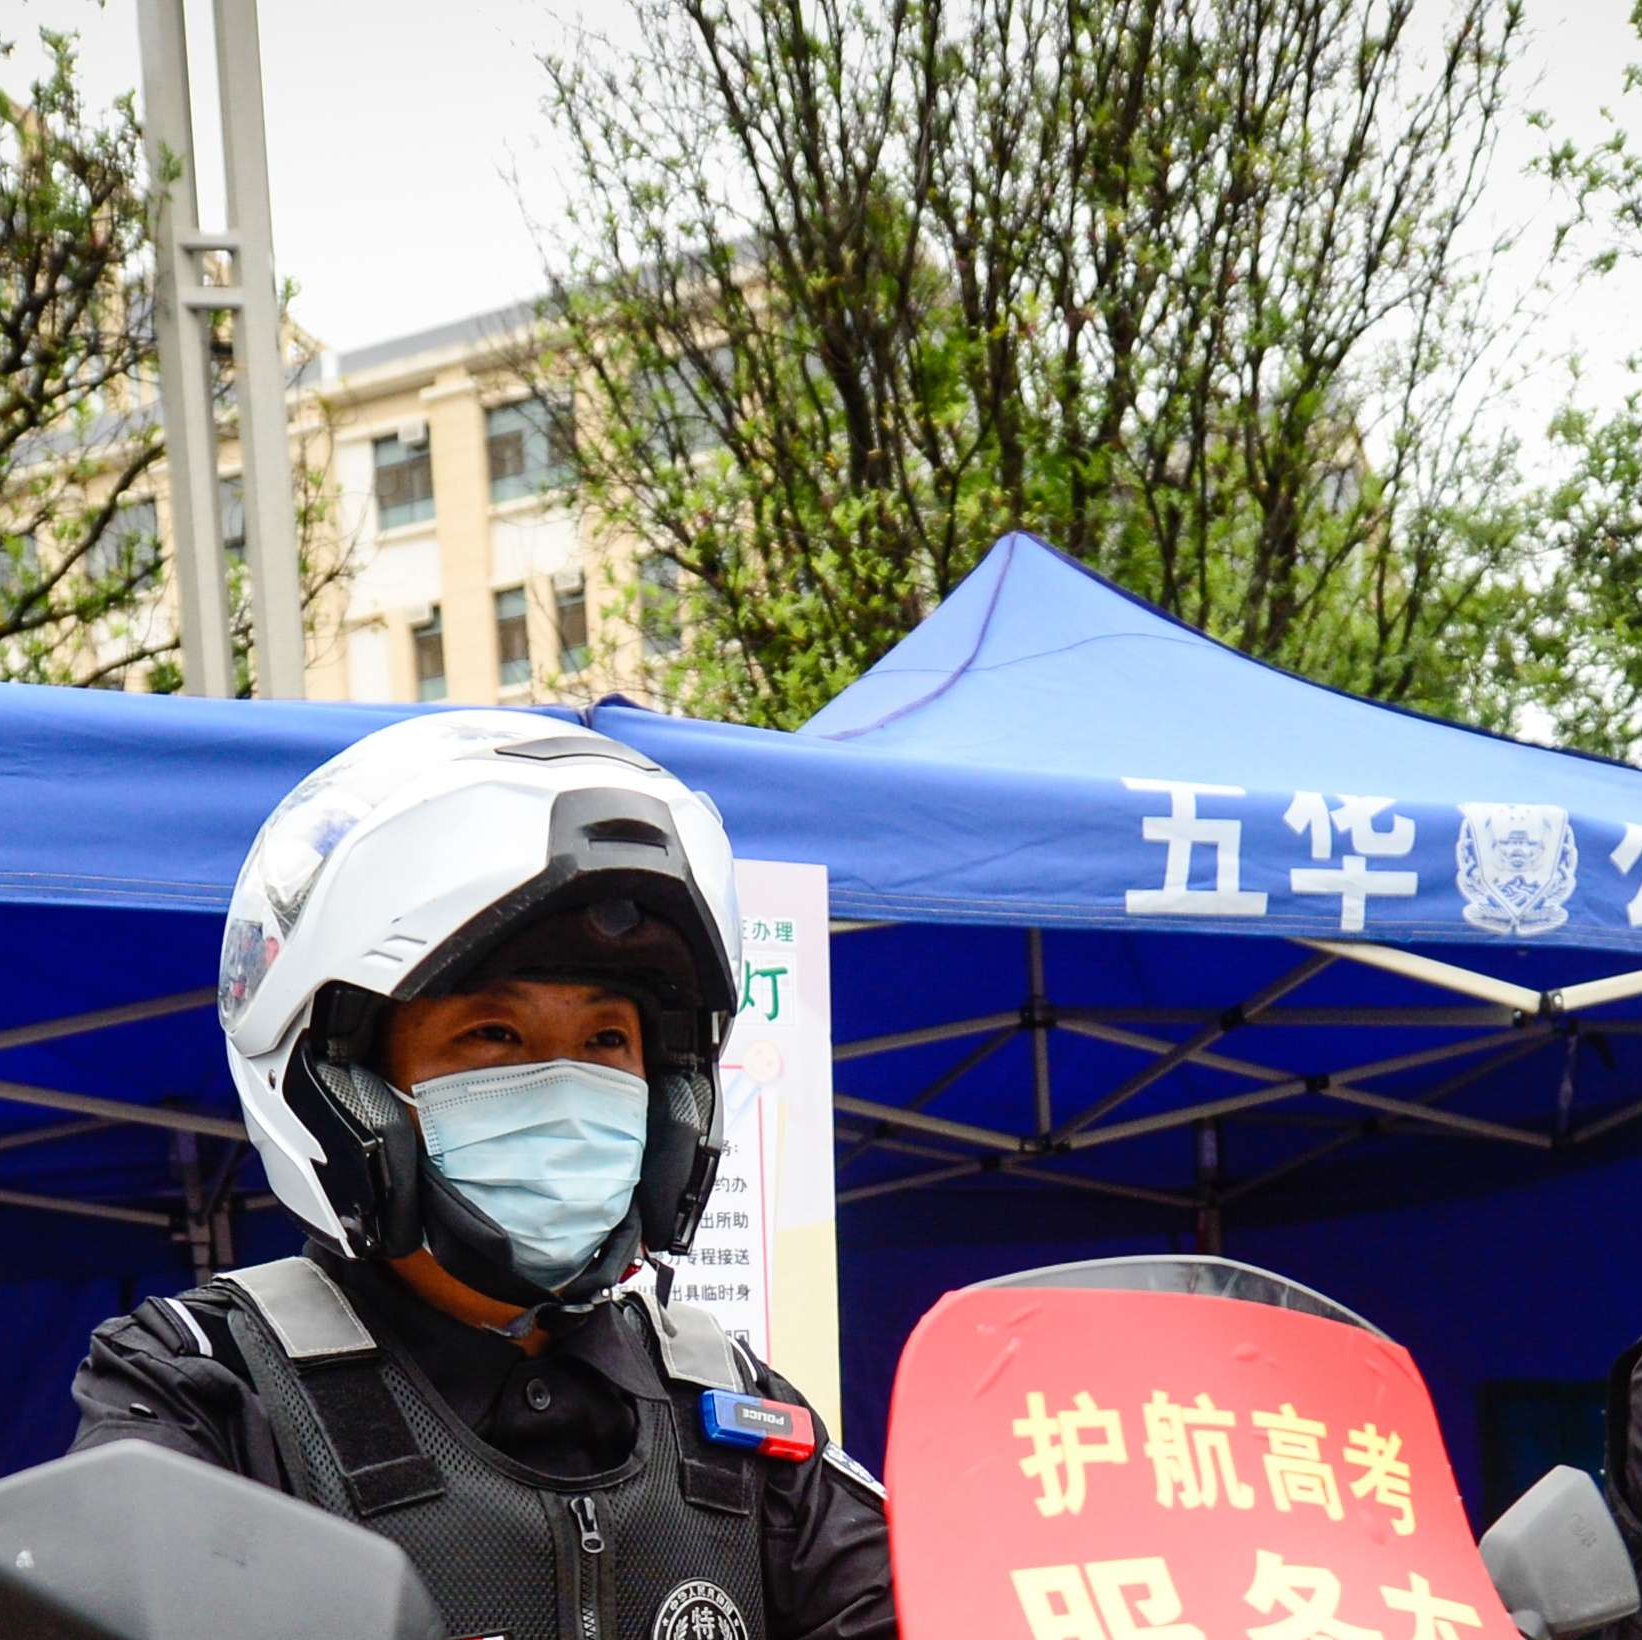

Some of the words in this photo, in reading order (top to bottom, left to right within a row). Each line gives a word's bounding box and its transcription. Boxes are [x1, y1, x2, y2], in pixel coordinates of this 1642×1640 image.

[1123, 777, 1418, 932] 五华
[741, 1407, 785, 1426] POLICE
[1013, 1391, 1417, 1537] 护航高考
